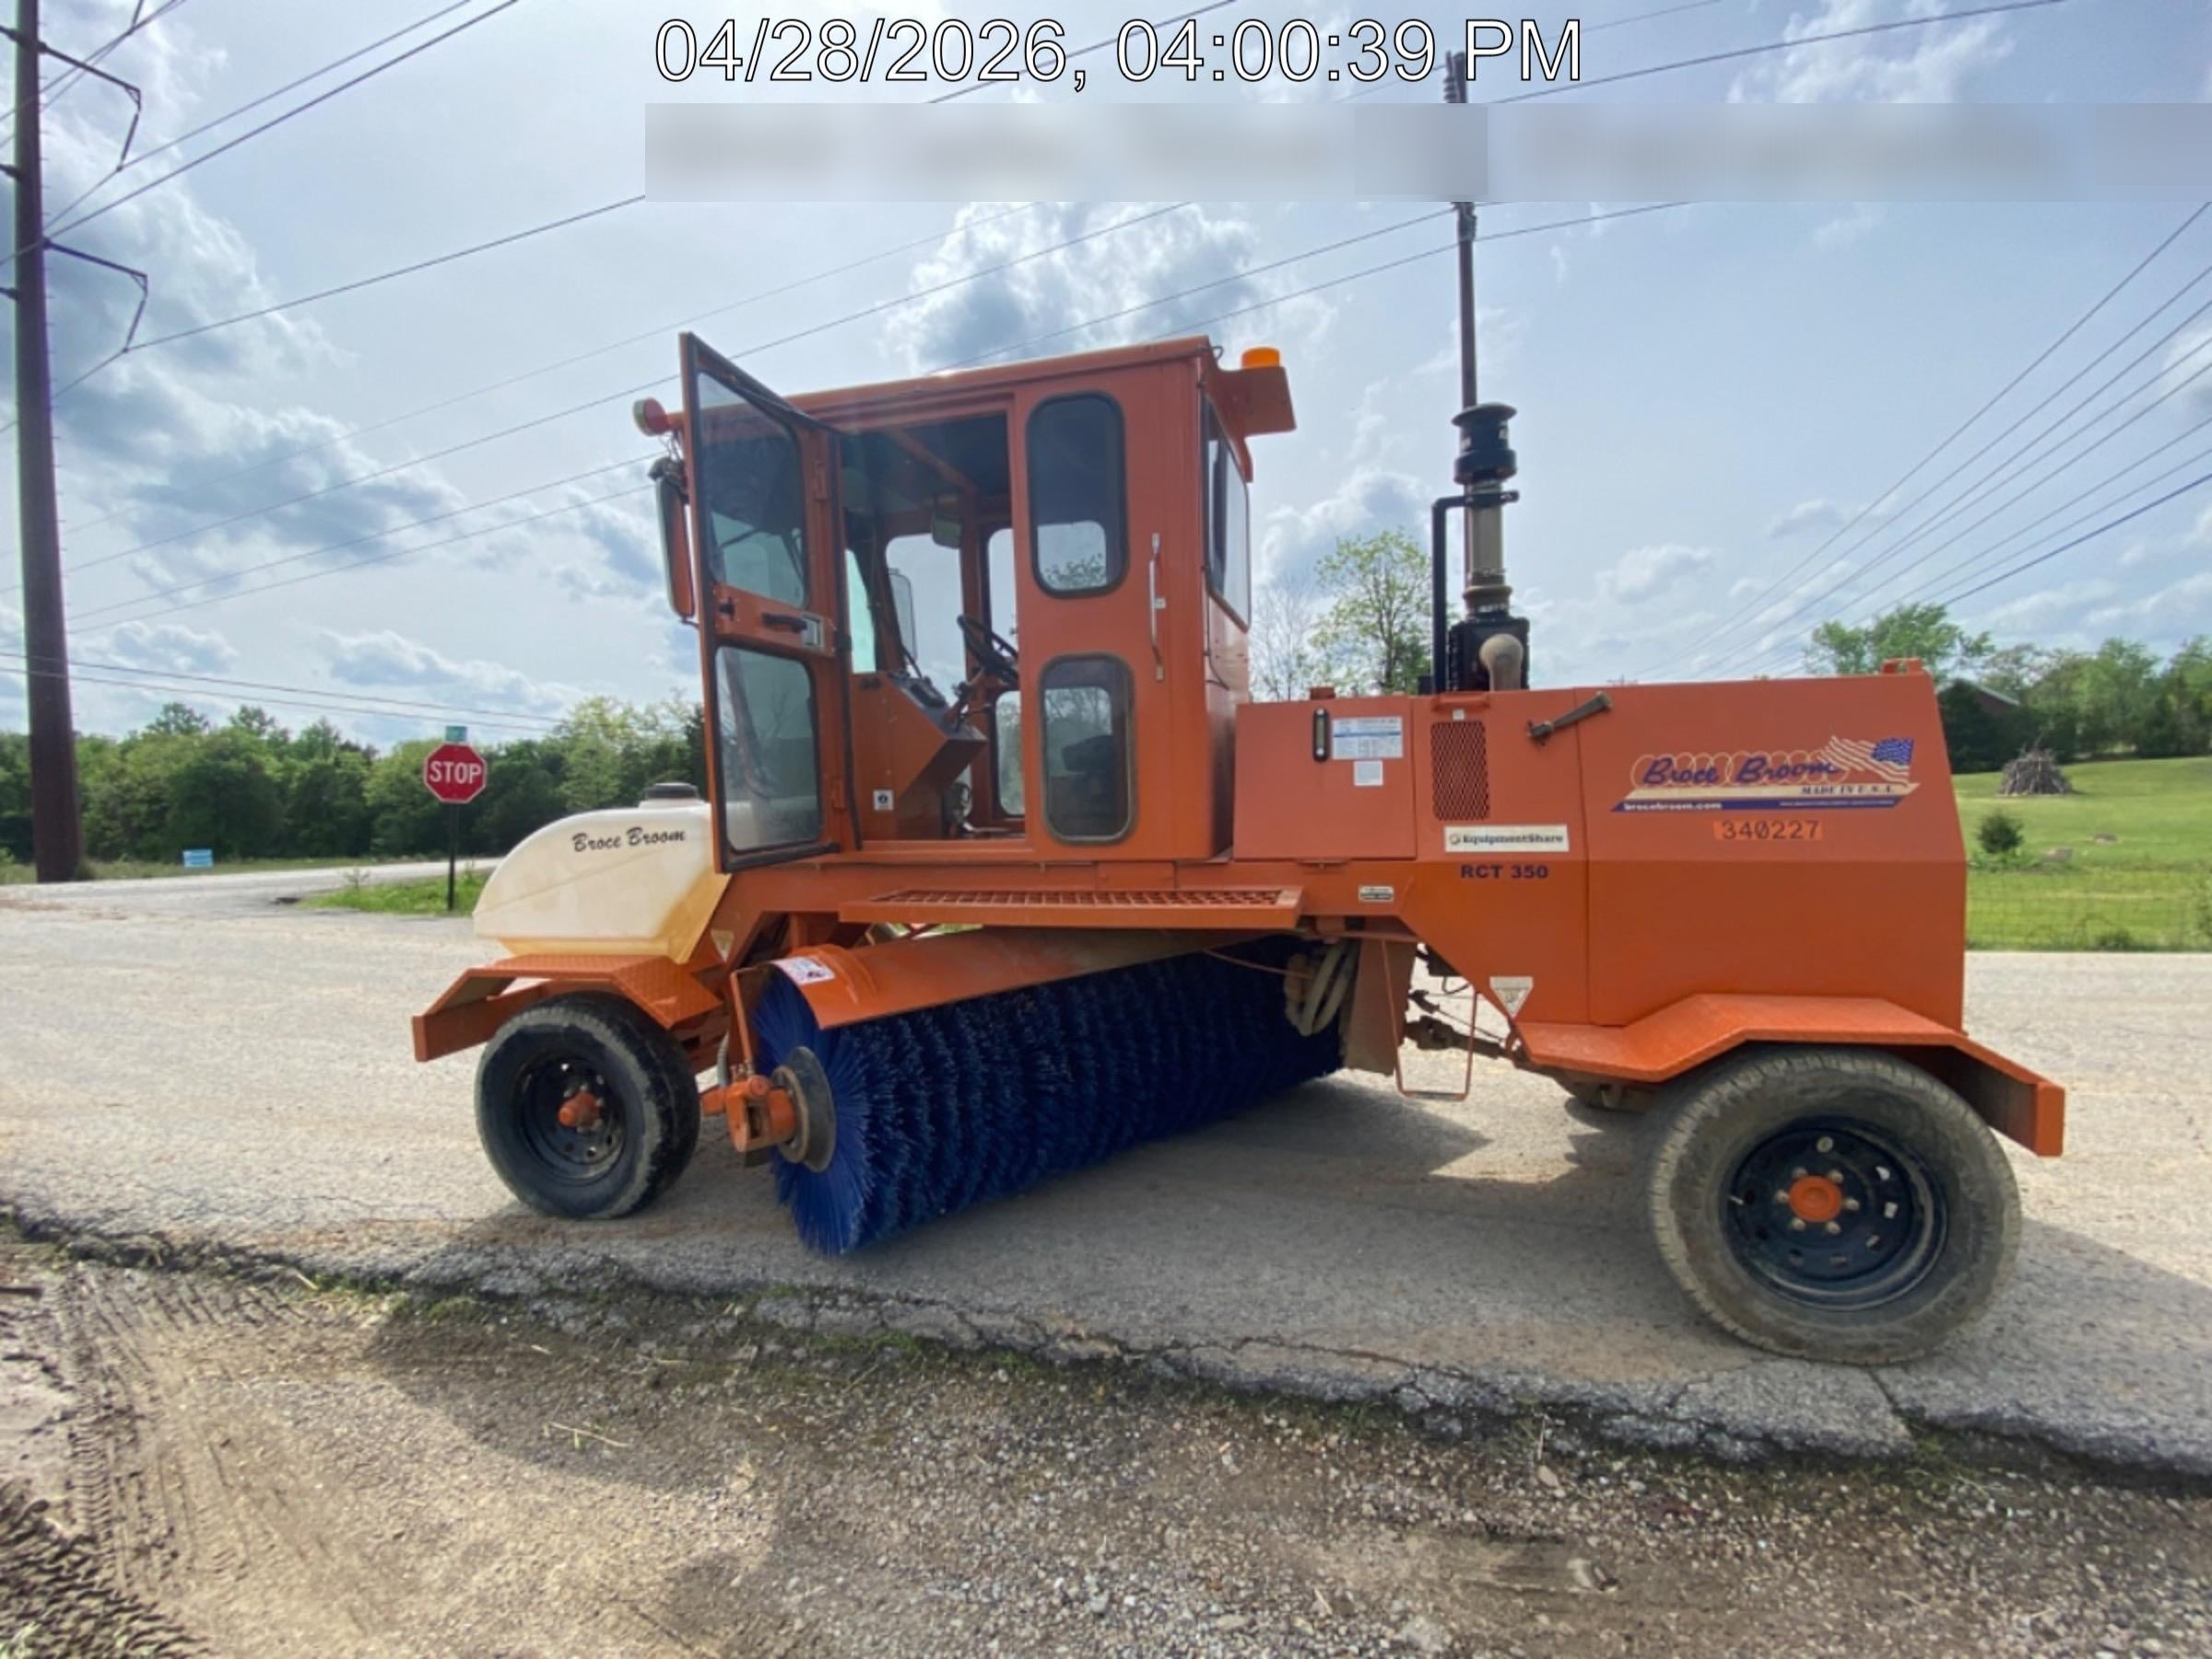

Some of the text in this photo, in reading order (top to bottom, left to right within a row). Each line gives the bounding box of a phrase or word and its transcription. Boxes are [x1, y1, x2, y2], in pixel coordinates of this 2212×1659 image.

[429, 760, 482, 784] STOP
[1642, 756, 1841, 784] Broce Broom
[571, 827, 686, 853] Broce Broom
[1463, 833, 1564, 845] EquipmentShare
[1720, 819, 1820, 841] 340227
[1460, 865, 1549, 879] RCT 350
